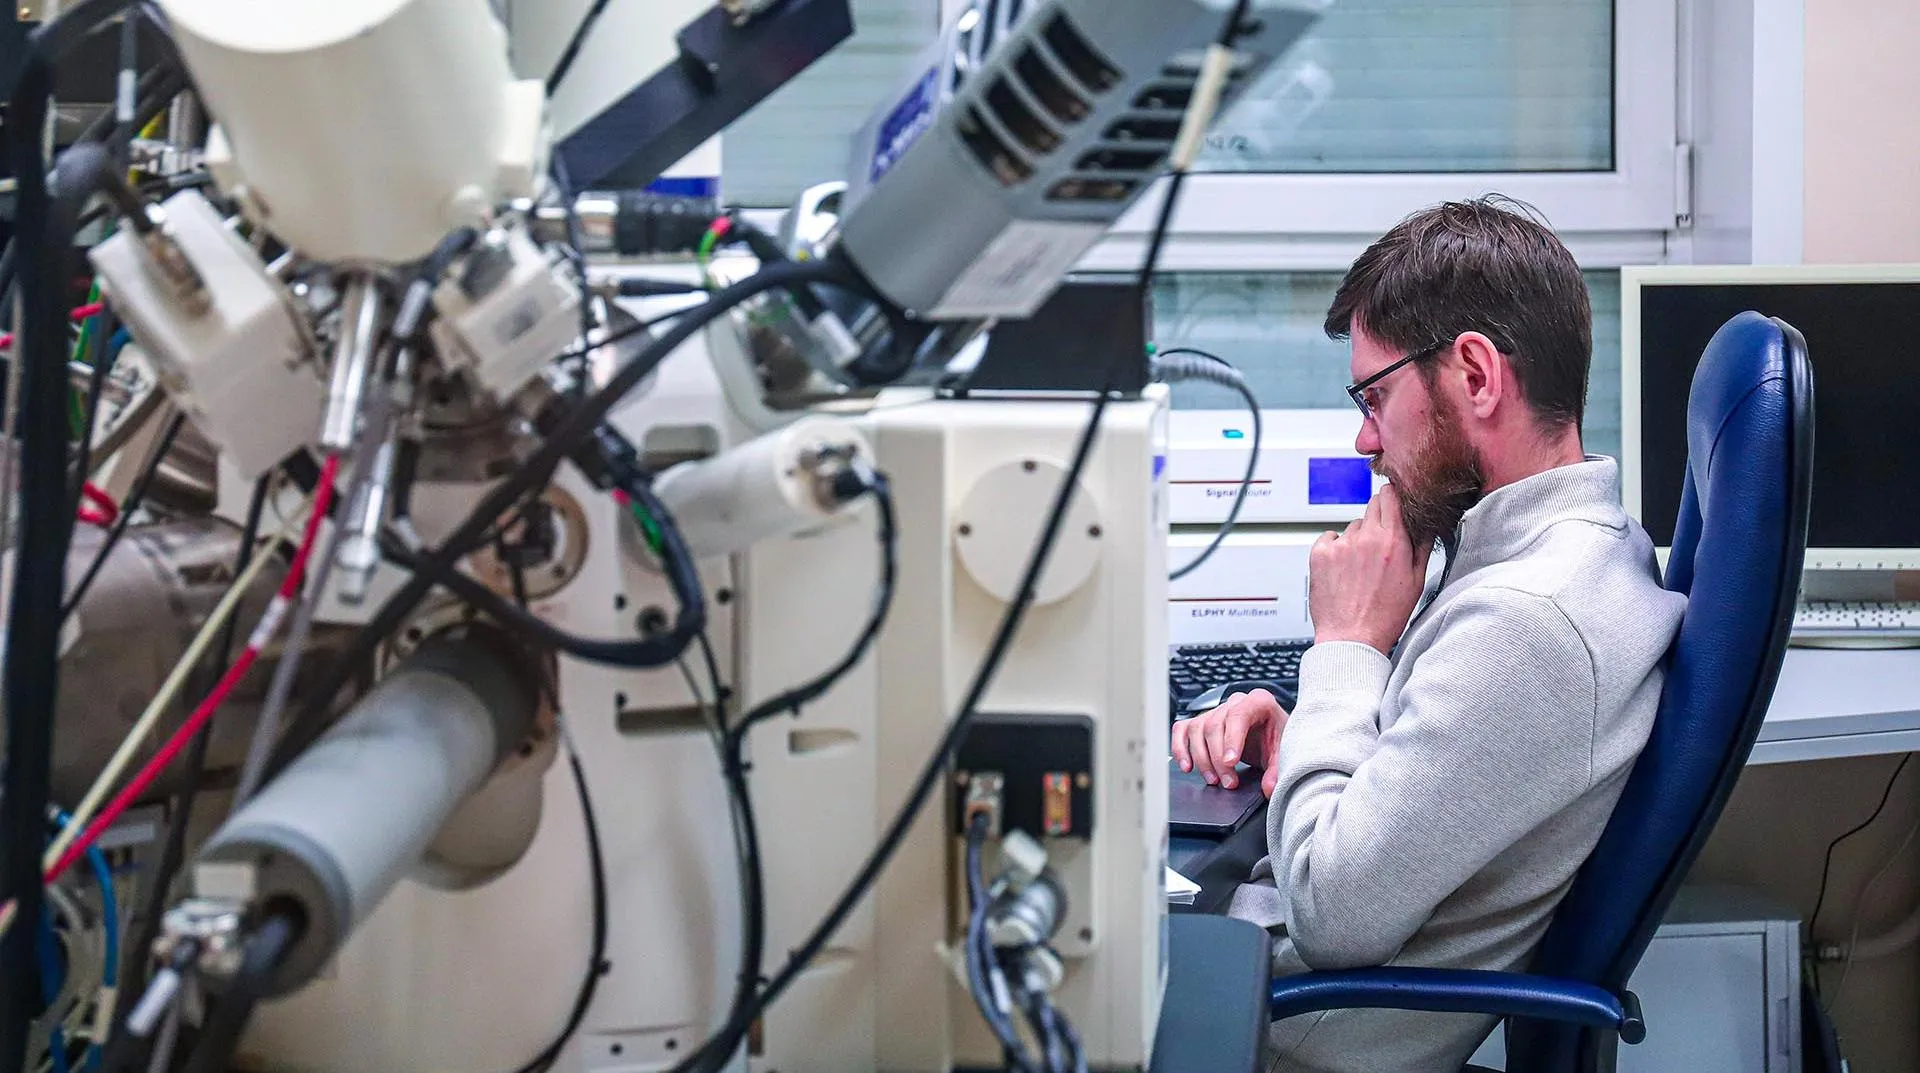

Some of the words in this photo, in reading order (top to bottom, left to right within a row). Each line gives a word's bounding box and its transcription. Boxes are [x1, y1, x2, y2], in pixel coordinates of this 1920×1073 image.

[1206, 488, 1238, 498] Signal
[1241, 488, 1272, 496] outer
[1191, 608, 1225, 617] ELPHY
[1228, 608, 1278, 617] MultiBeam
